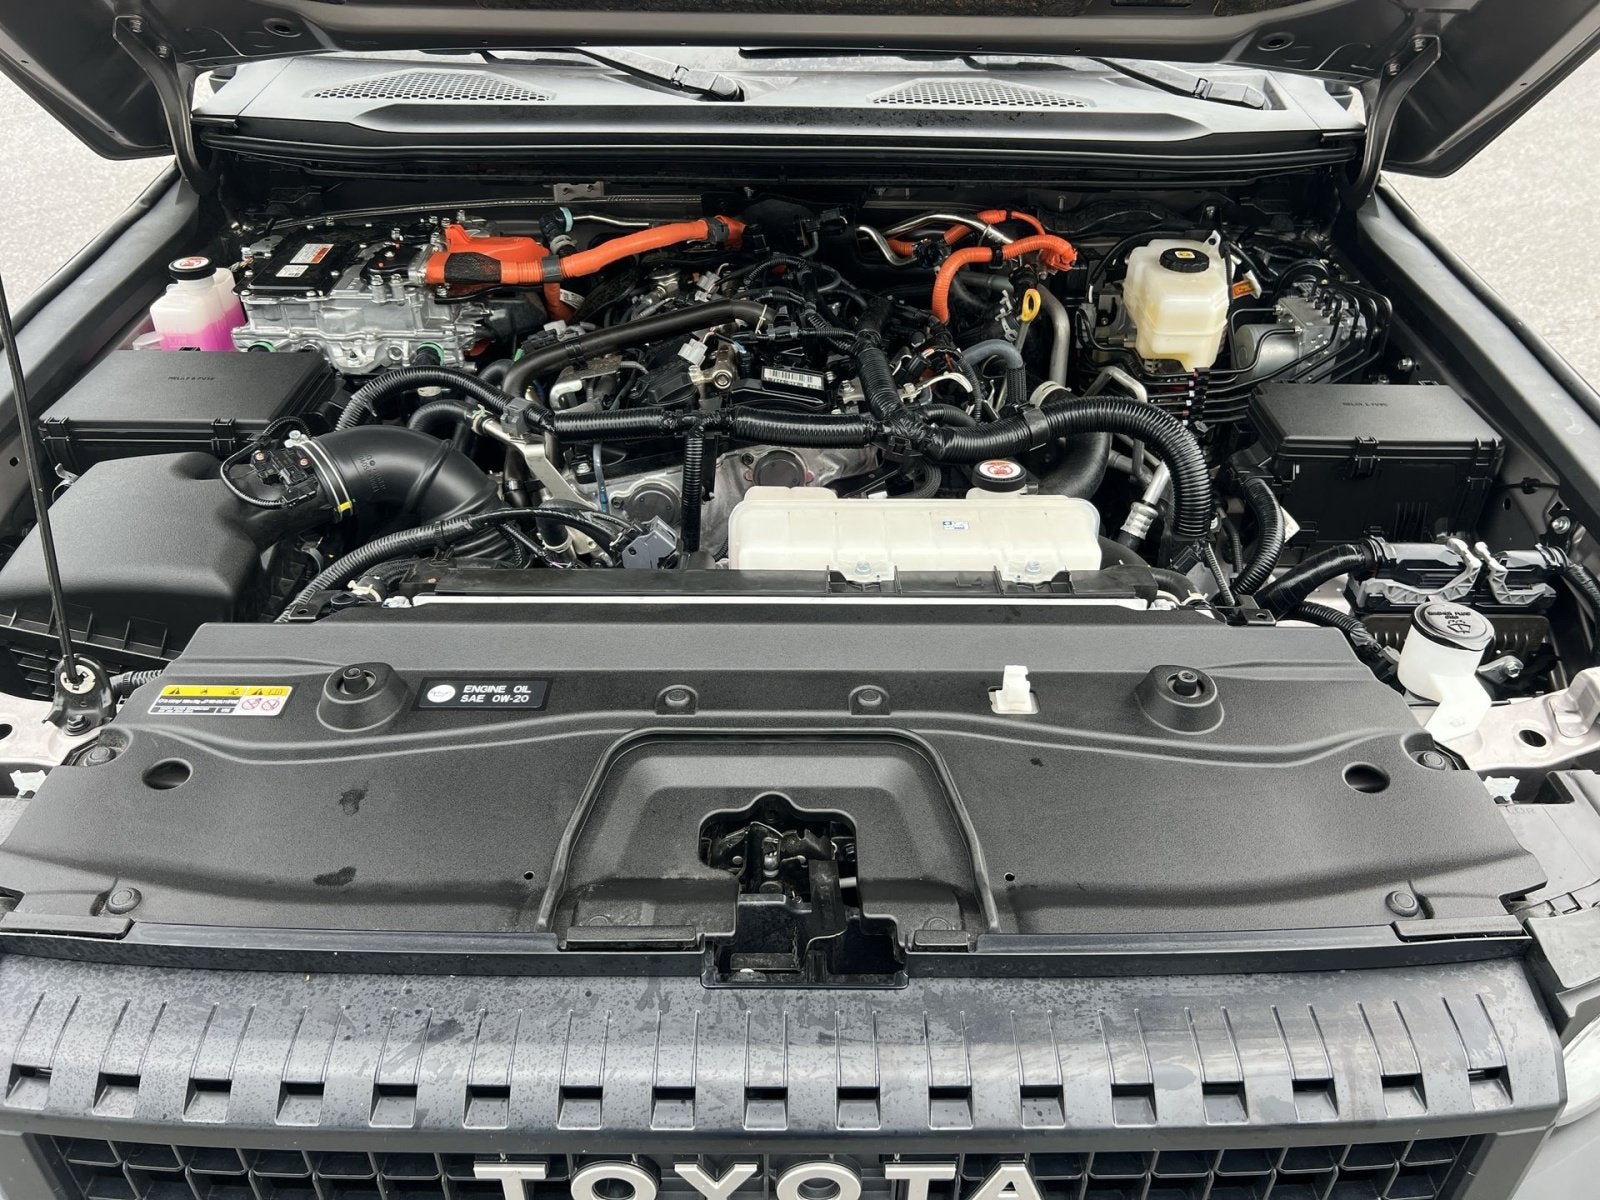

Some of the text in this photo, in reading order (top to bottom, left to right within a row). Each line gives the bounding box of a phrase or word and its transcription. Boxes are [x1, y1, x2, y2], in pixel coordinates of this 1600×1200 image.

[463, 684, 507, 694] ENGINE
[513, 685, 532, 694] OIL
[459, 694, 486, 703] SAE
[491, 694, 530, 703] 0W-20
[473, 1161, 1040, 1200] TOYOTA
